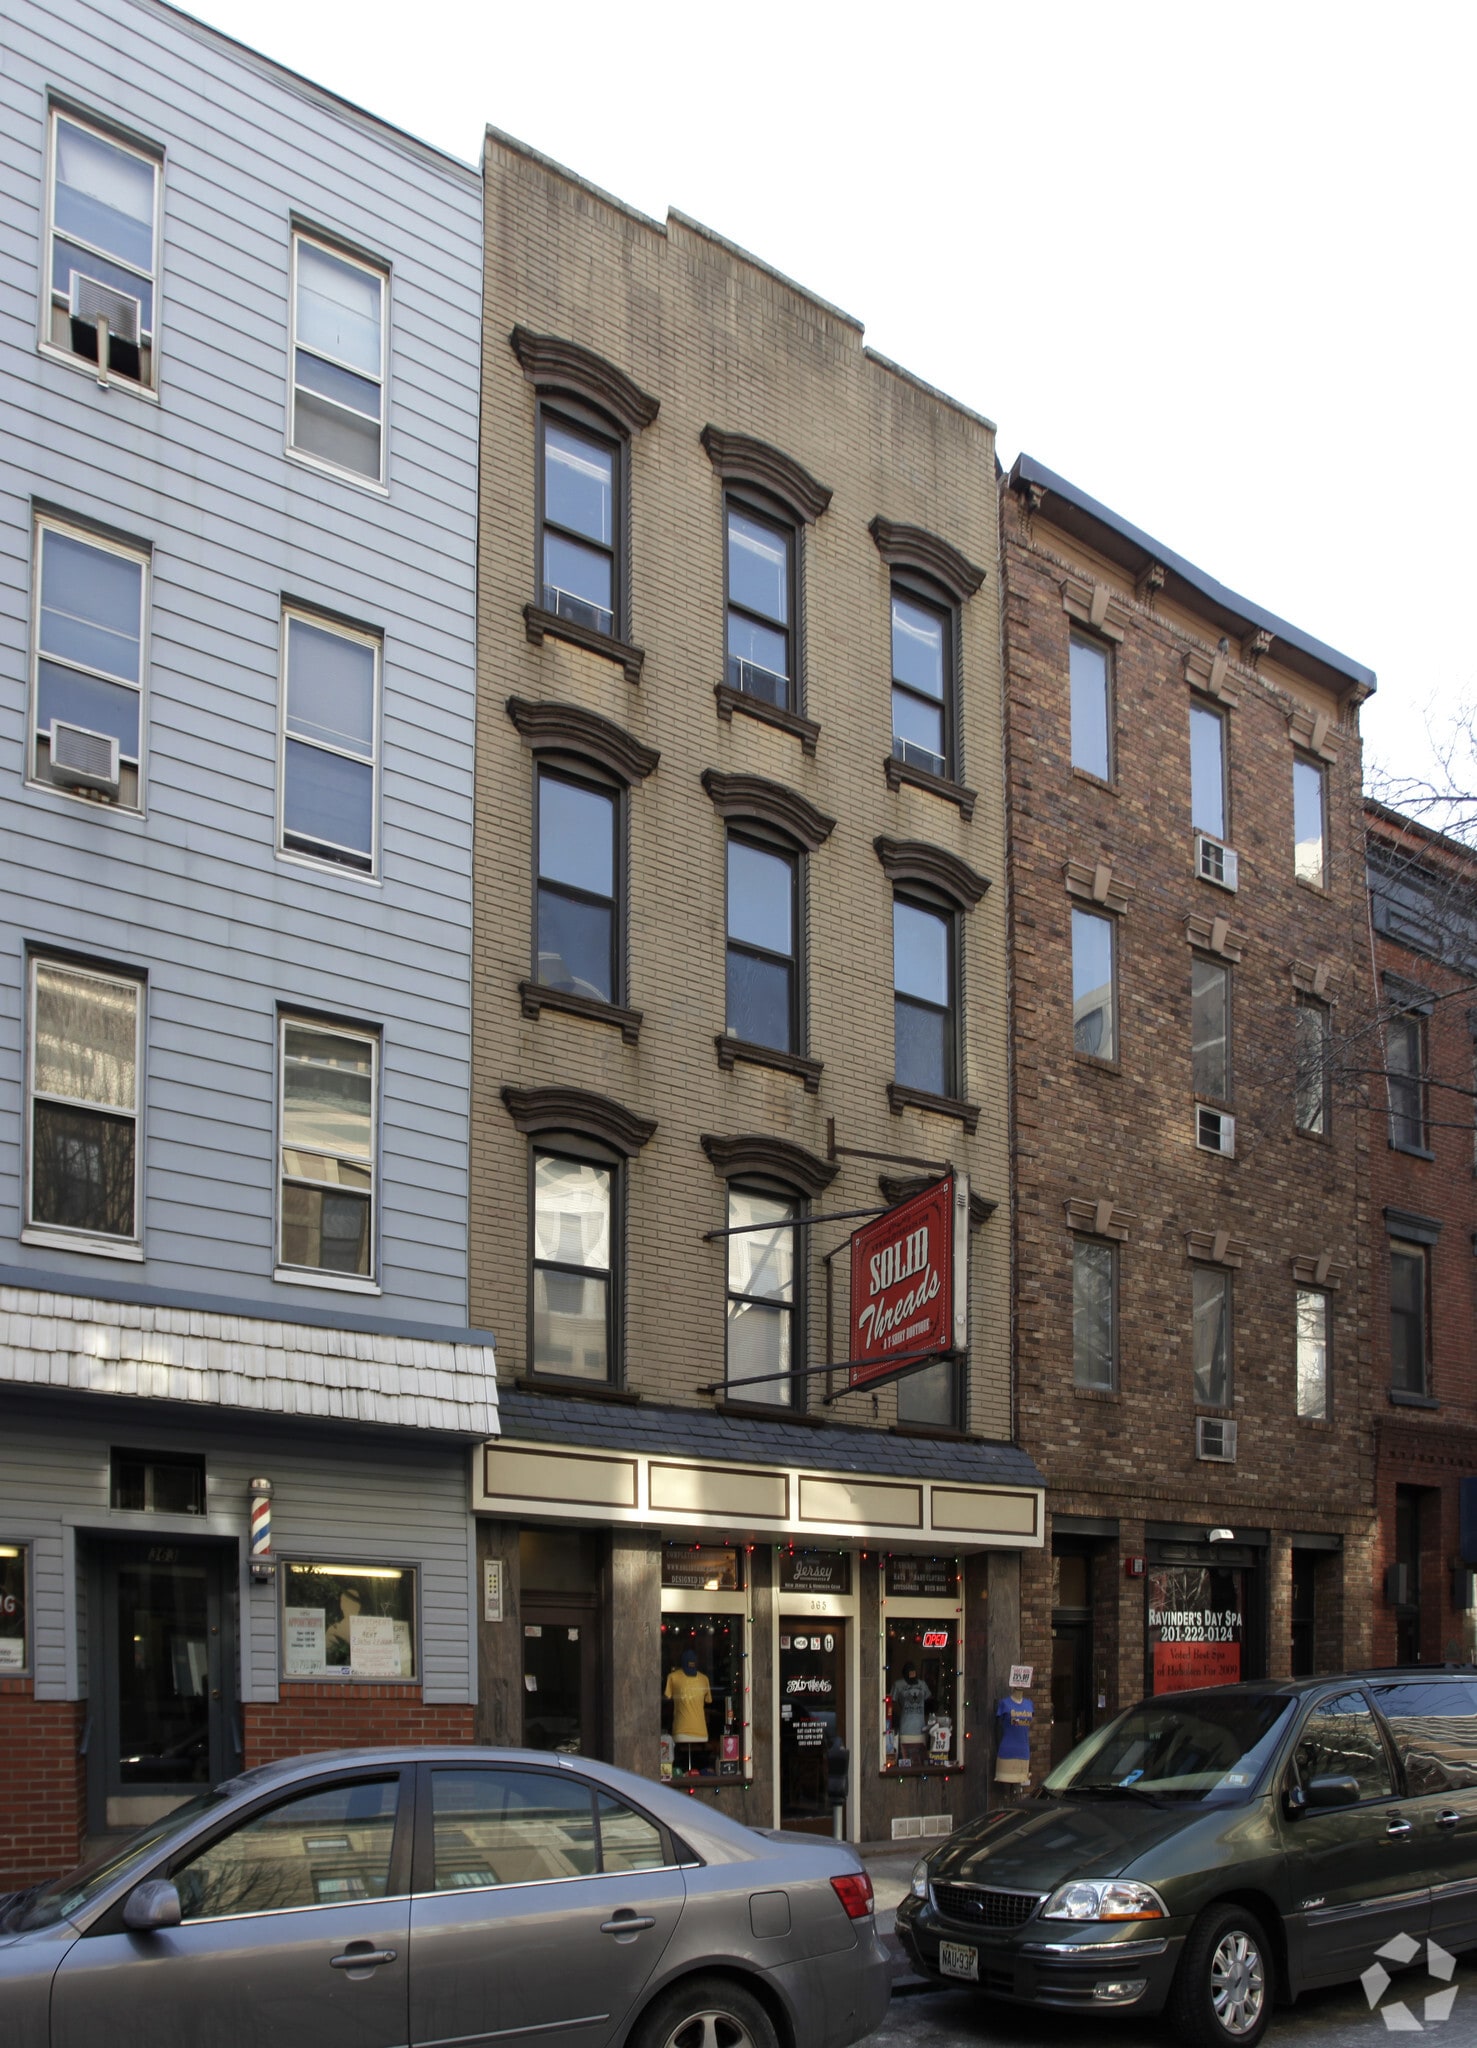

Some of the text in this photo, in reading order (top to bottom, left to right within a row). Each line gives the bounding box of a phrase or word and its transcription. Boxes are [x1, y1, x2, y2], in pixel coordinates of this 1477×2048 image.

[870, 1226, 928, 1296] SOLID
[859, 1263, 940, 1350] Threads
[888, 1327, 906, 1347] T-SHIRT
[906, 1317, 930, 1341] BOUTIQUE
[671, 1575, 698, 1584] DESIGNED
[793, 1561, 832, 1582] Jersey
[811, 1600, 827, 1611] 365
[1148, 1609, 1242, 1627] RAVINDER'S DAY SPA
[925, 1633, 946, 1646] OPEN
[1160, 1626, 1234, 1642] 201-222-0124
[1170, 1648, 1191, 1660] Voted
[1193, 1648, 1210, 1660] Best
